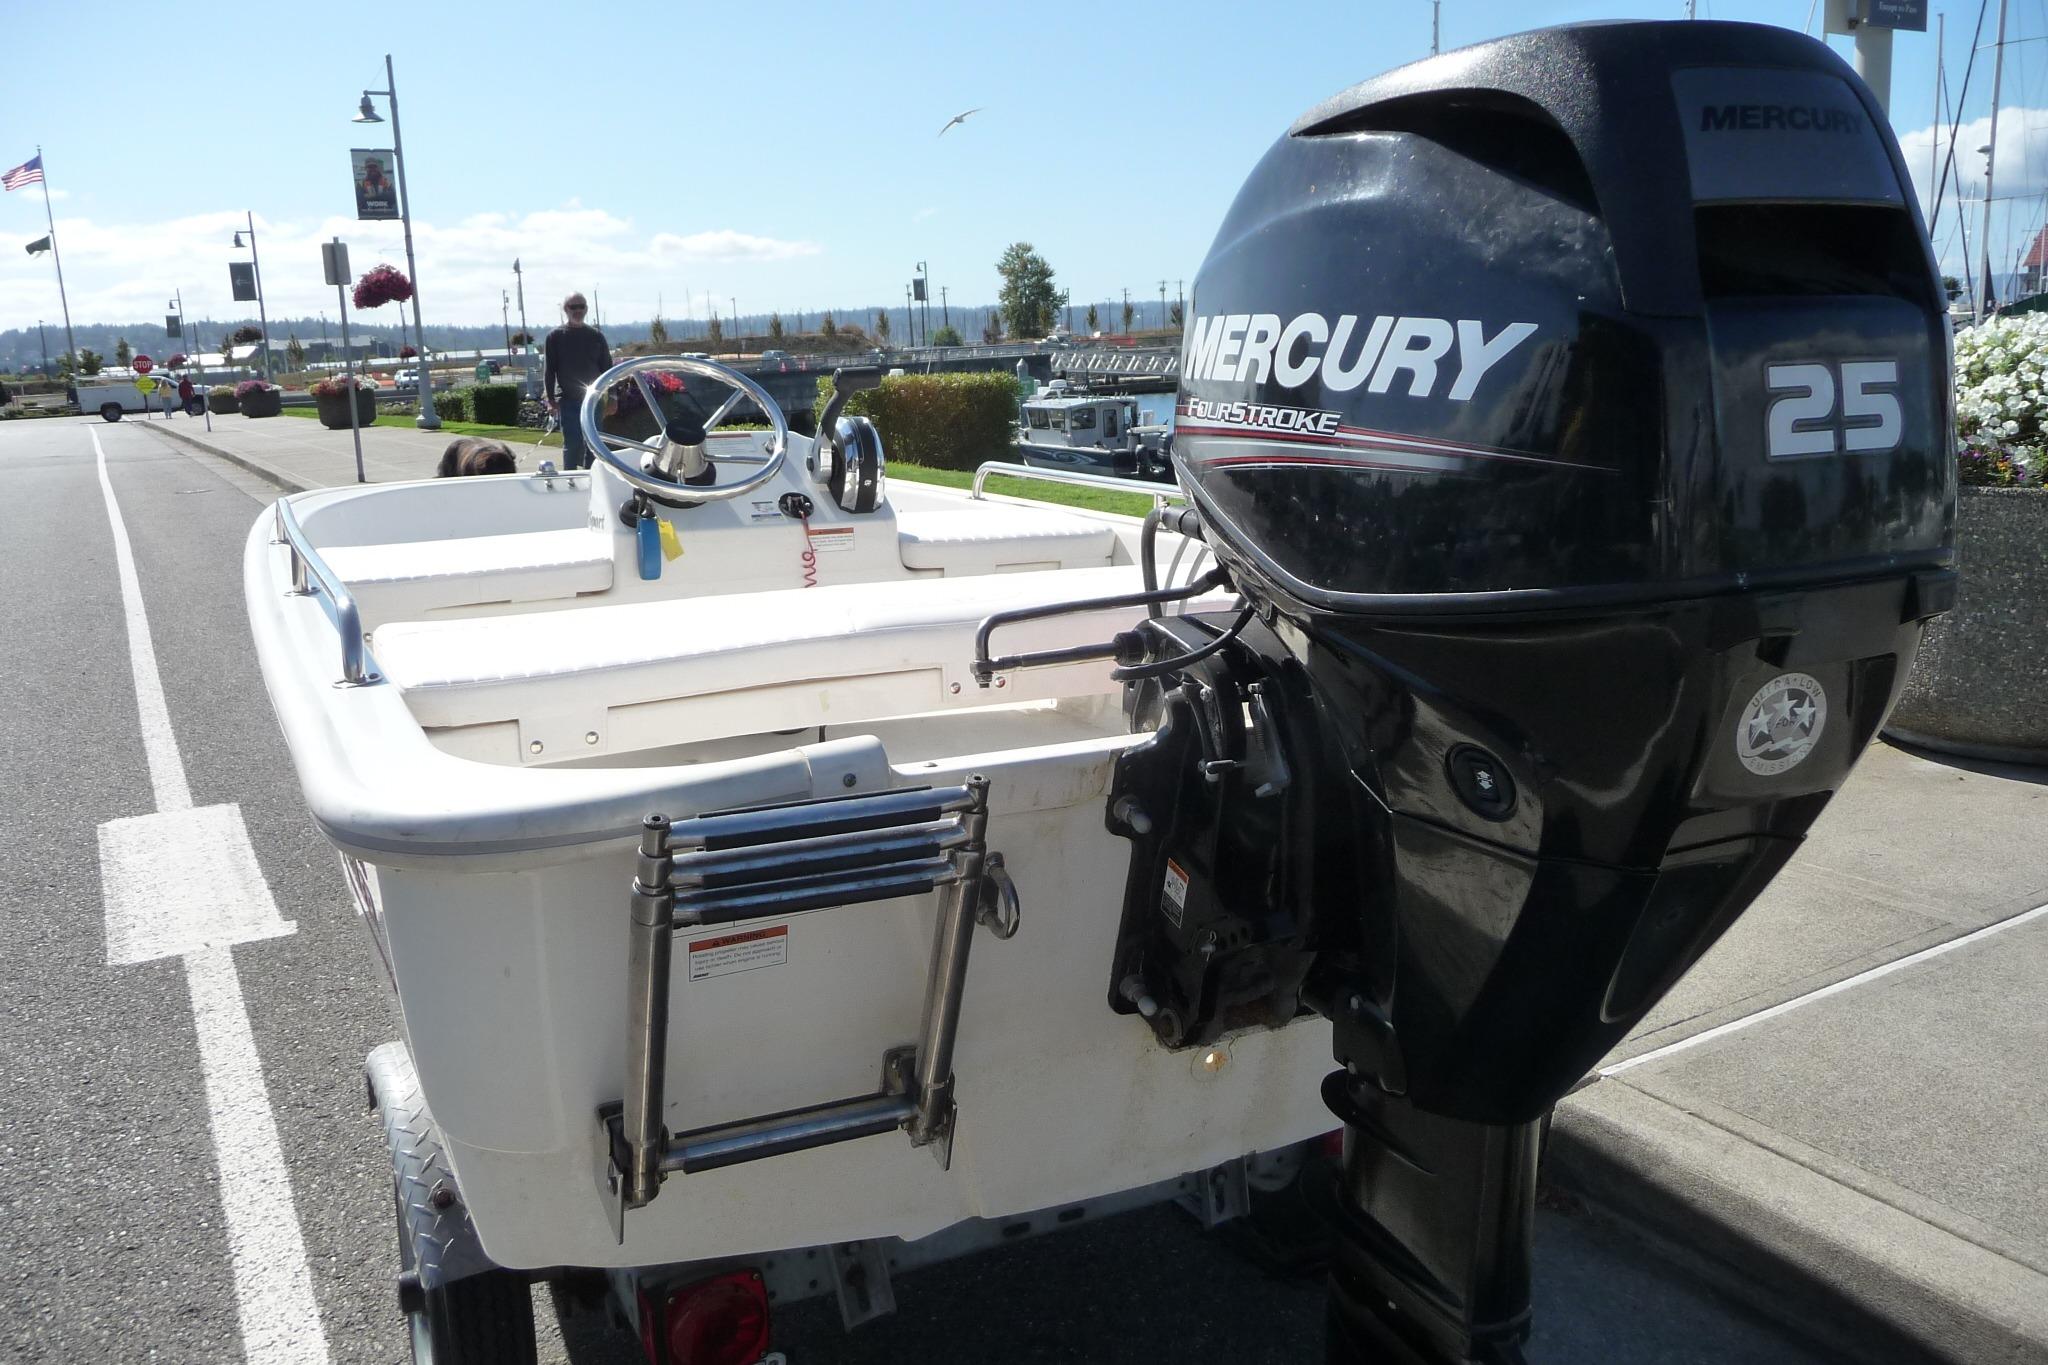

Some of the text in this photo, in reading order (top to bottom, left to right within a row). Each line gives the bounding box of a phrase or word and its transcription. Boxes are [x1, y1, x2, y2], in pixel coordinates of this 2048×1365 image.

[1701, 105, 1867, 134] MERCURY
[134, 360, 152, 369] STOP
[1185, 312, 1539, 400] MERCURY
[1768, 361, 1902, 457] 25
[722, 932, 767, 945] WARNING
